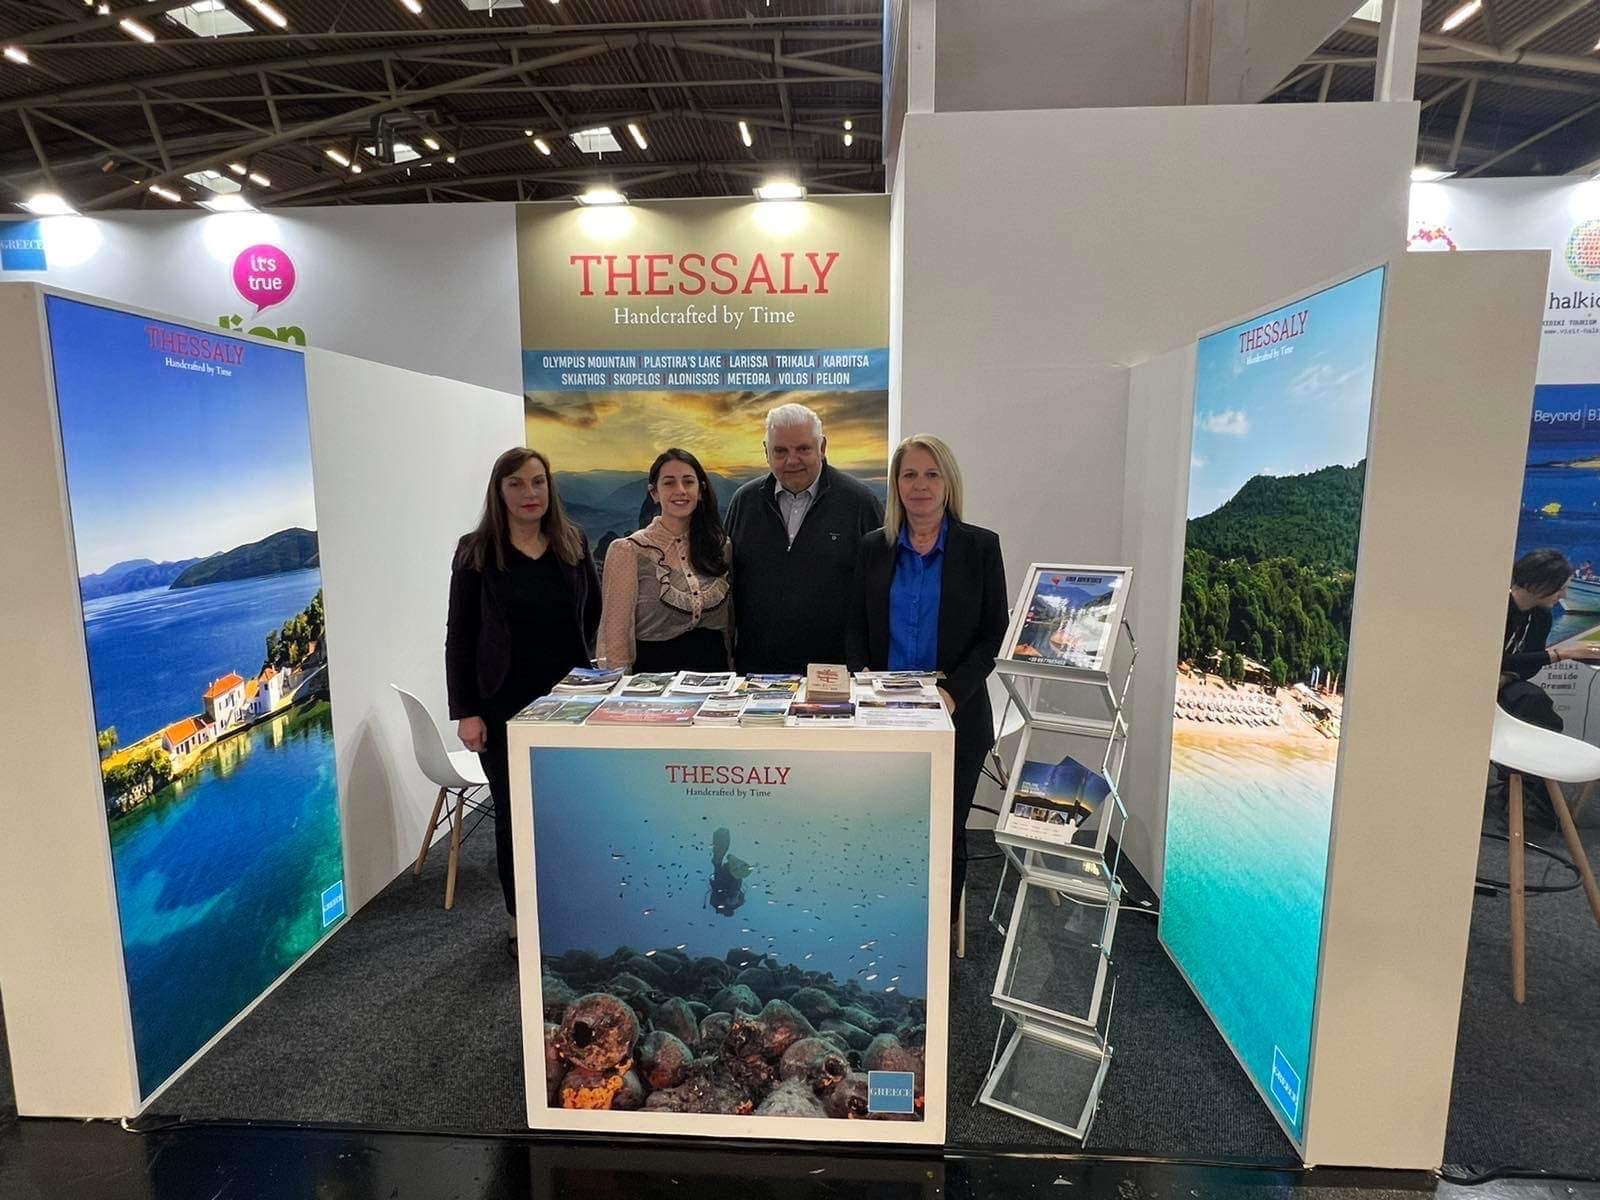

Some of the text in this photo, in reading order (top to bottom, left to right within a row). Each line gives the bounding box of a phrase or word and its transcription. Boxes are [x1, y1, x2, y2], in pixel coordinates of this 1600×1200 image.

[569, 252, 840, 296] THESSALY
[248, 275, 283, 291] true
[614, 304, 795, 330] Handcrafted by Time
[1239, 310, 1309, 353] THESSALY
[146, 326, 244, 365] THESSALY
[542, 355, 870, 369] OLYMPUS MOUNTAIN PLASTIRA'S LAKE LARISSA TRIKALA KARDITSA
[561, 372, 850, 386] SKIATHOS SKOPELOS ALONISSOS METEORA VOLOS PELION
[1535, 409, 1582, 425] Beyond
[664, 764, 792, 785] THESSALY
[685, 787, 771, 799] Handcrafted by Time
[870, 1087, 912, 1097] GREECE
